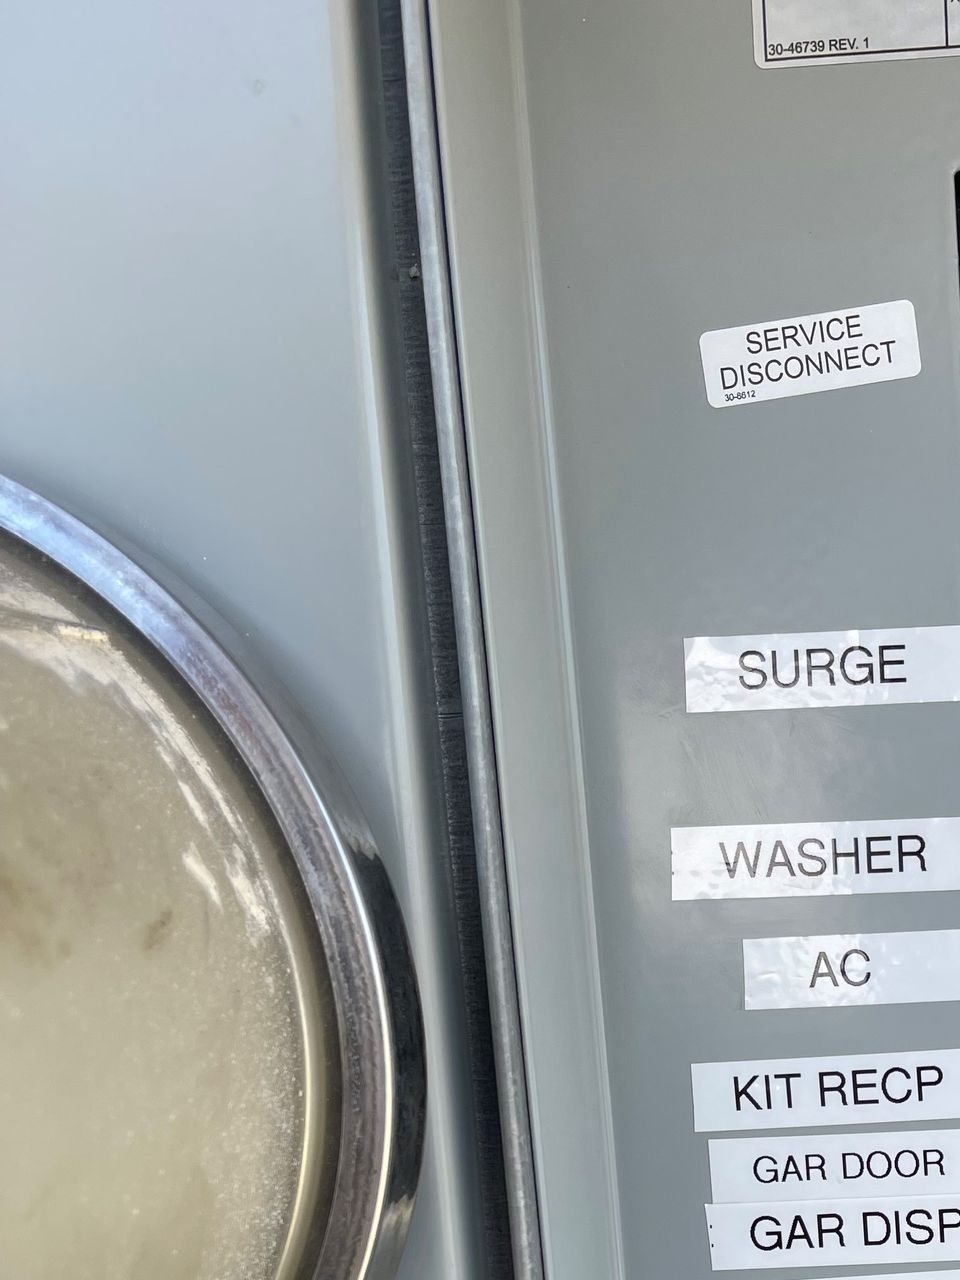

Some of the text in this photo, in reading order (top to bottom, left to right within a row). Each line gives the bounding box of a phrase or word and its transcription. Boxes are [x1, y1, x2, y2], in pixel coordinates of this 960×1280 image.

[768, 37, 869, 56] 30-46739 REV. 1
[746, 314, 863, 354] SERVICE
[720, 340, 896, 390] DISCONNECT
[738, 644, 907, 690] SURGE
[719, 834, 928, 879] WASHER
[809, 948, 872, 988] AC
[732, 1065, 944, 1112] KIT RECP
[753, 1149, 946, 1184] GAR DOOR
[750, 1213, 846, 1251] GAR
